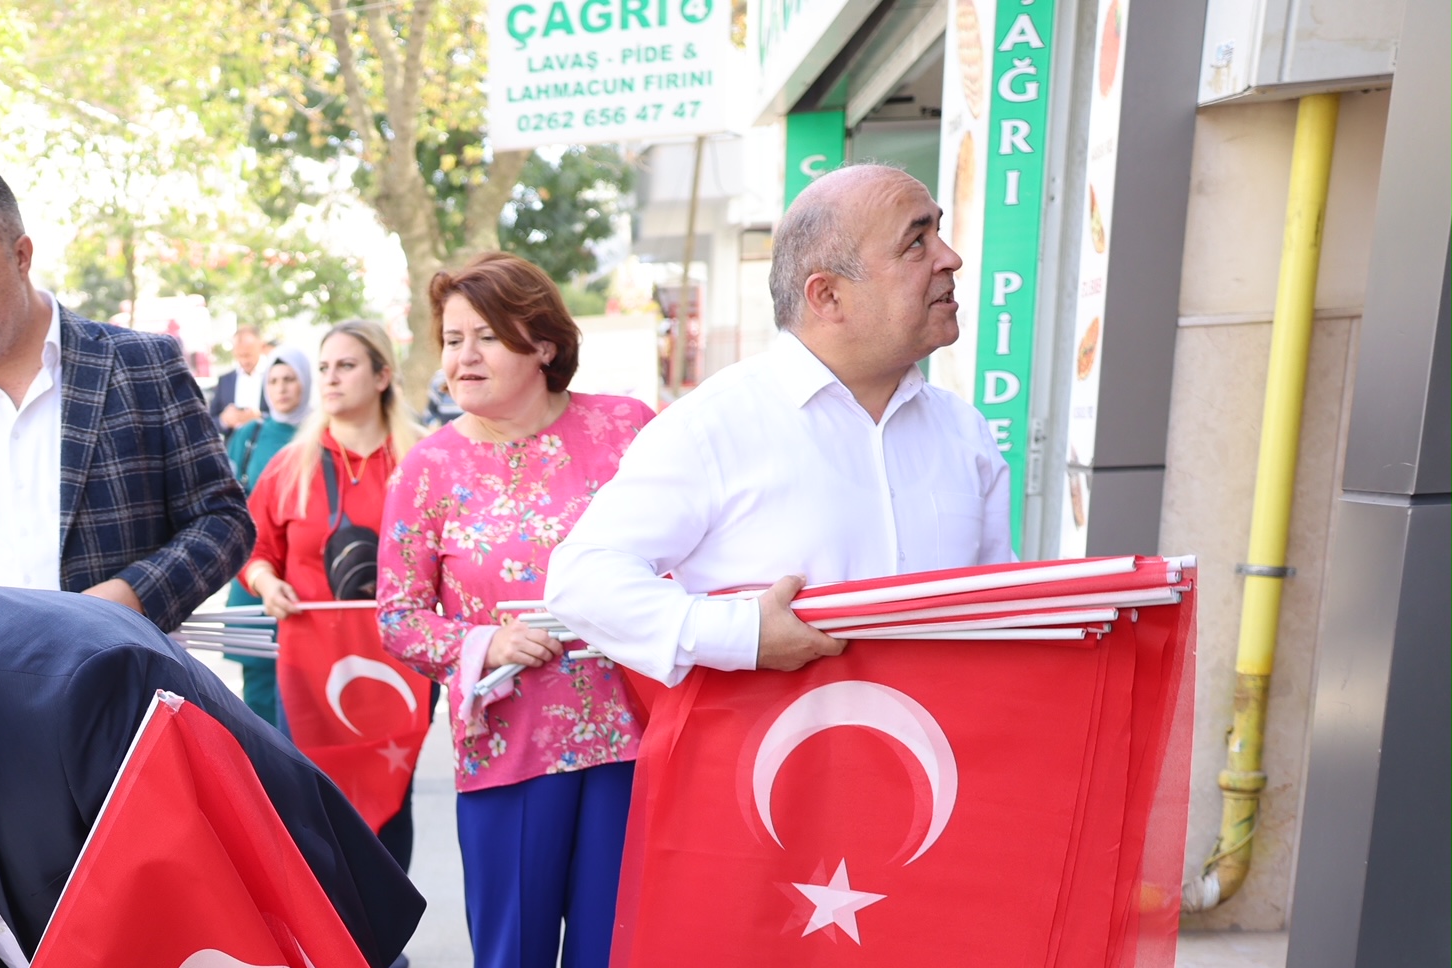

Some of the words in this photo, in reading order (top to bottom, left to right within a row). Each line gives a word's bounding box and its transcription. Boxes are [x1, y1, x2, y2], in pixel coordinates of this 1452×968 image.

[527, 51, 599, 73] LAVAŞ
[621, 43, 673, 65] PİDE
[682, 42, 698, 60] &
[506, 77, 636, 103] LAHMACUN
[644, 69, 714, 91] FIRINI
[995, 0, 1046, 206] AĞRI
[516, 110, 575, 132] 0262
[583, 106, 628, 127] 656
[635, 102, 664, 122] 47
[672, 100, 703, 119] 47
[981, 270, 1024, 452] PİDE
